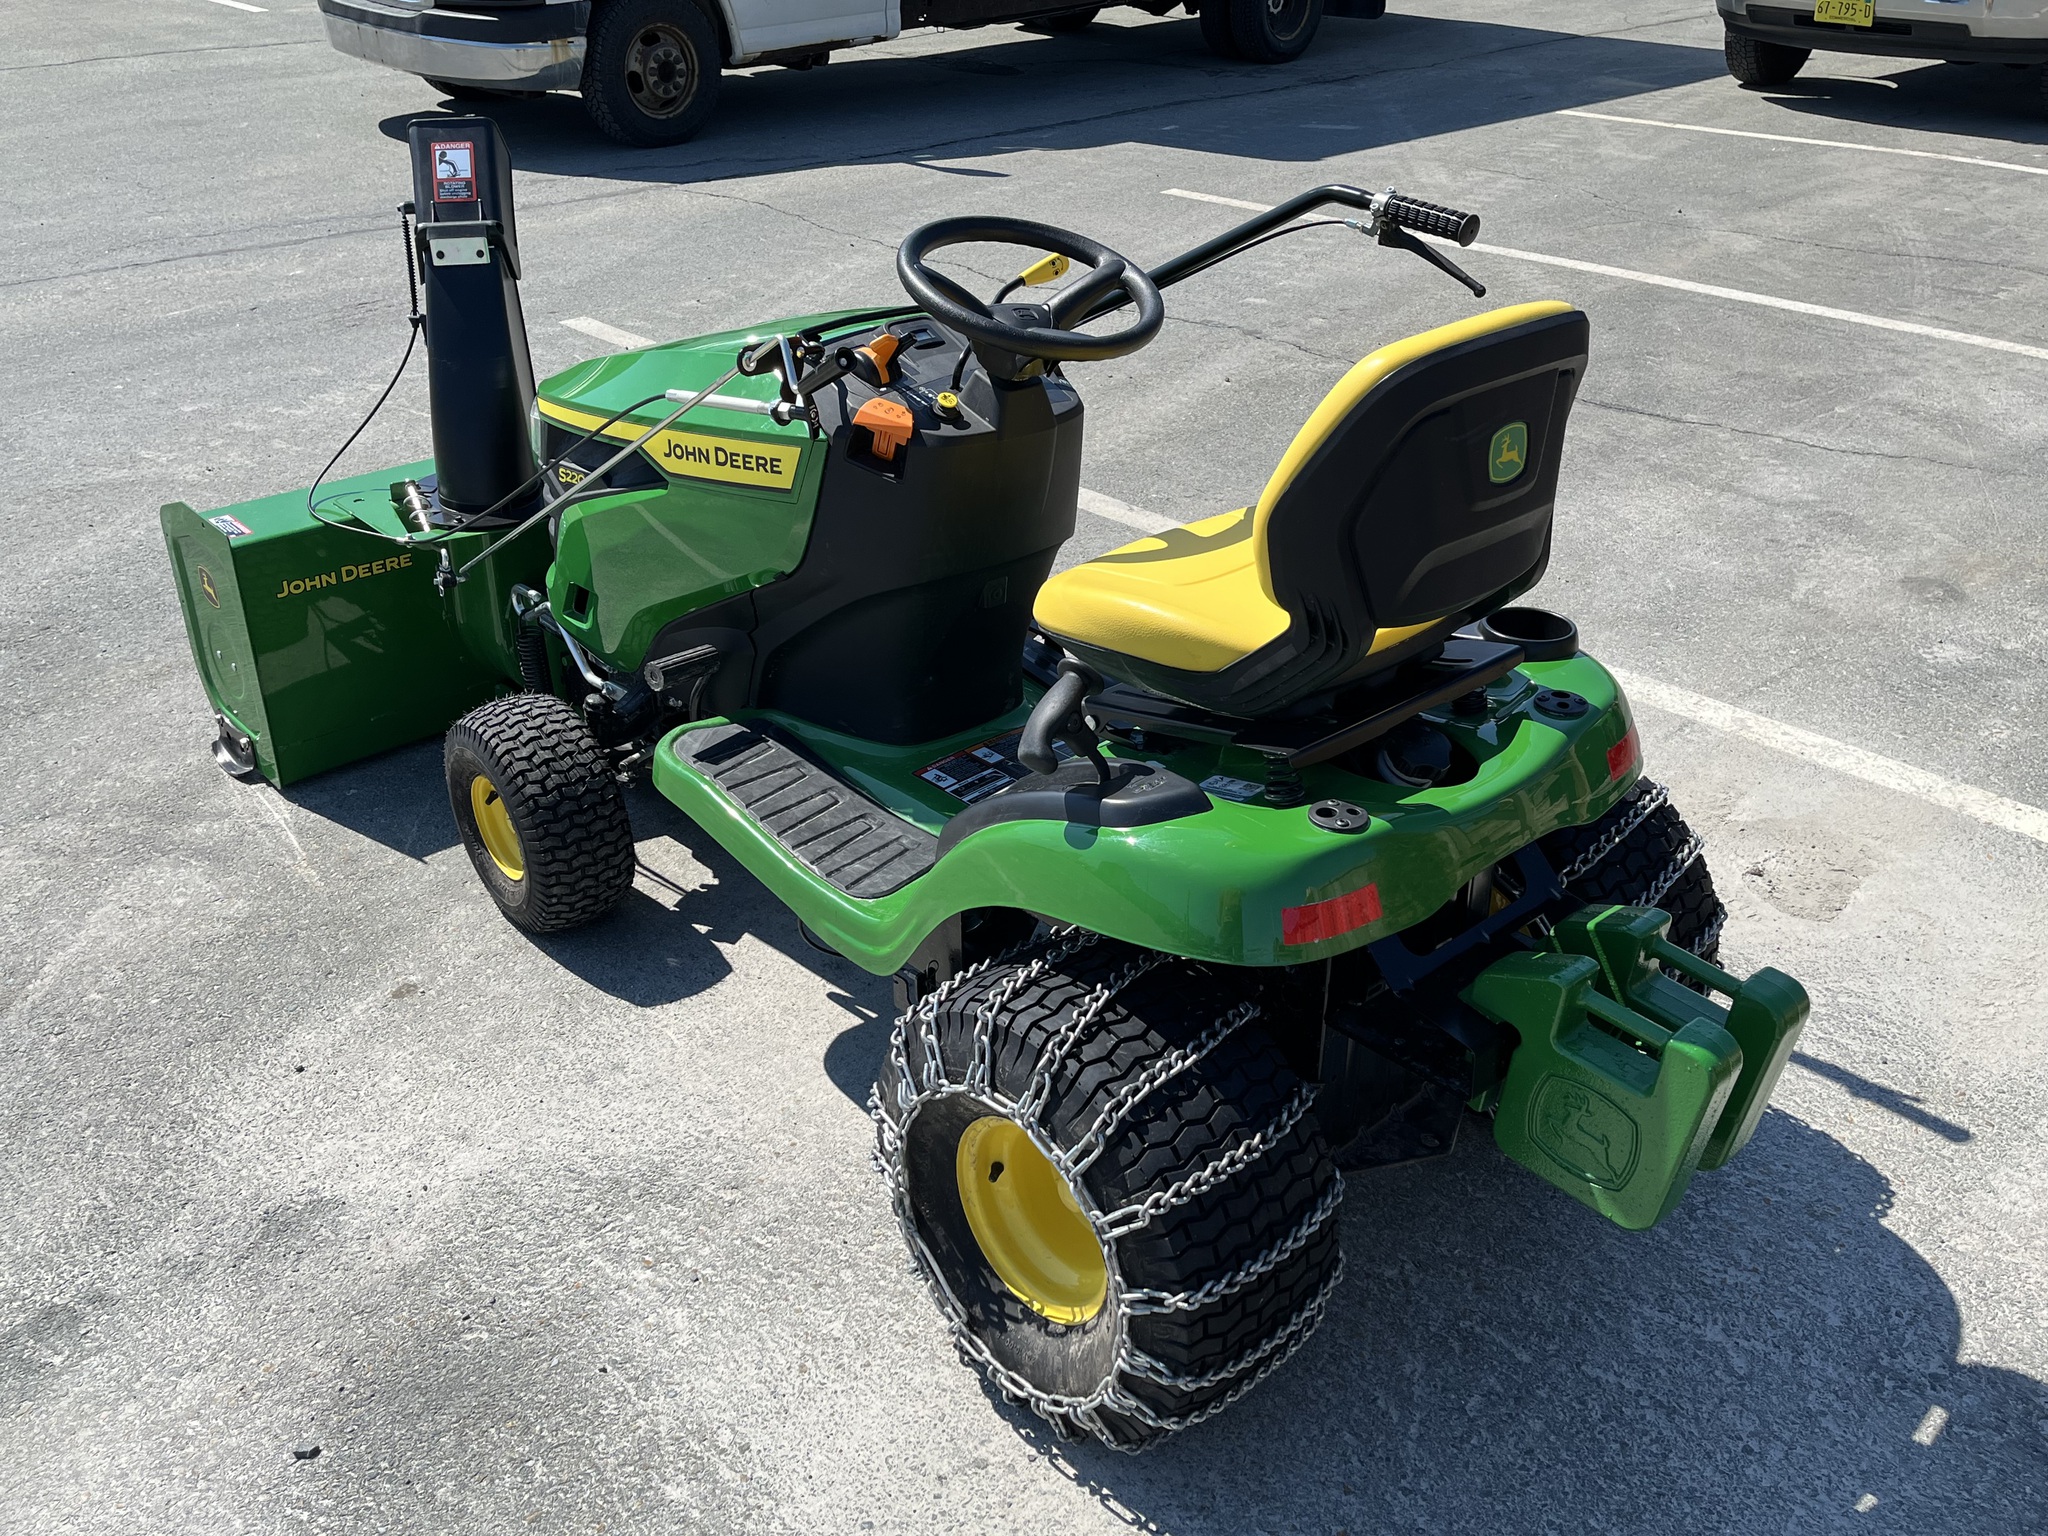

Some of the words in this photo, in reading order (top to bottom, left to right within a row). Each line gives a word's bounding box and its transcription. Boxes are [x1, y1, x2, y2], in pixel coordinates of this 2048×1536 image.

[1817, 1, 1871, 18] 67-795-D
[663, 438, 711, 465] JOHN
[714, 446, 783, 475] DEERE
[276, 571, 338, 599] JOHN
[340, 553, 413, 583] DEERE
